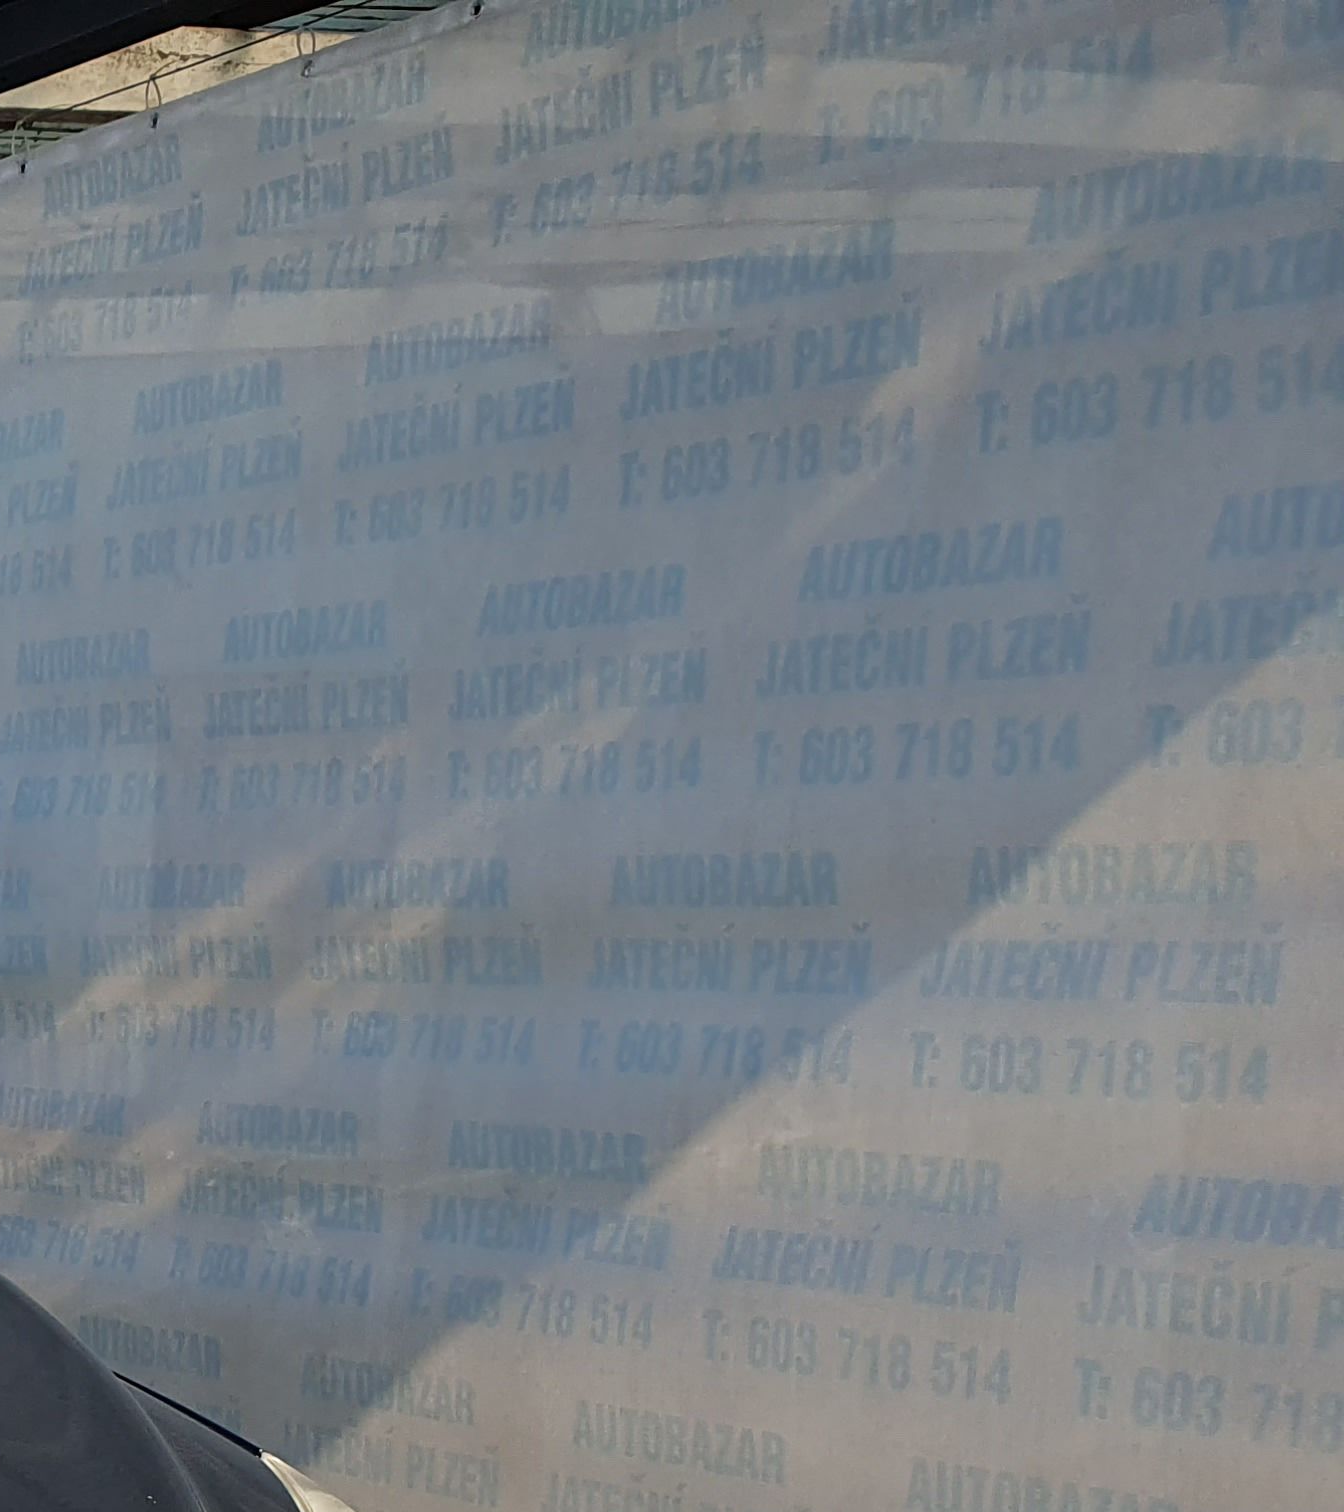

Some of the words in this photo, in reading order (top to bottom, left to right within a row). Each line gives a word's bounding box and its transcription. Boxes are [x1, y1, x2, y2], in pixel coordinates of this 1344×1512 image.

[793, 290, 921, 384] PLZEŇ
[132, 360, 285, 430] AUTOBAZAR
[475, 363, 576, 445] PLZEŇ
[975, 393, 1008, 448] T:
[1030, 377, 1112, 440] 603
[1143, 356, 1230, 422] 718
[221, 418, 304, 490] PLZEŇ
[618, 455, 645, 503] T:
[662, 442, 725, 496] 603
[749, 426, 816, 482] 718
[8, 461, 77, 526] PLZEŇ
[334, 501, 355, 544] T:
[369, 490, 420, 538] 603
[439, 479, 492, 529] 718
[510, 466, 571, 518] 514
[32, 548, 73, 589] 514
[103, 539, 120, 577] T:
[131, 530, 173, 573] 603
[188, 519, 231, 564] 718
[246, 511, 295, 557] 514
[804, 520, 1062, 598] AUTOBAZAR
[224, 602, 388, 660] AUTOBAZAR
[481, 567, 684, 633] AUTOBAZAR
[15, 632, 151, 683] AUTOBAZAR
[597, 632, 708, 707] PLZEŇ
[949, 594, 1091, 680] PLZEŇ
[99, 684, 173, 744] PLZEŇ
[321, 661, 411, 728] PLZEŇ
[752, 734, 781, 781] T:
[799, 730, 869, 780] 603
[896, 722, 969, 775] 718
[995, 717, 1080, 771] 514
[1209, 703, 1300, 761] 603
[15, 779, 52, 815] 603
[199, 770, 217, 808] T:
[230, 765, 276, 805] 603
[292, 760, 339, 802] 718
[354, 758, 407, 801] 514
[447, 754, 470, 796] T:
[636, 739, 703, 786] 514
[612, 856, 836, 903] AUTOBAZAR
[444, 921, 542, 984] PLZEŇ
[750, 923, 874, 994] PLZEŇ
[1126, 922, 1285, 1002] PLZEŇ
[311, 1011, 331, 1050] T:
[409, 1016, 461, 1058] 718
[477, 1019, 536, 1063] 514
[578, 1024, 603, 1068] T:
[616, 1025, 677, 1071] 603
[698, 1029, 762, 1077] 718
[908, 1035, 940, 1084] T:
[960, 1037, 1038, 1089] 603
[1066, 1040, 1148, 1094] 718
[1176, 1043, 1271, 1099] 514
[449, 1122, 645, 1181] AUTOBAZAR
[200, 1243, 244, 1285] 603
[319, 1260, 371, 1306] 514
[517, 1286, 573, 1334] 718
[591, 1296, 655, 1347] 514
[702, 1311, 729, 1358] T:
[746, 1317, 813, 1371] 603
[837, 1331, 908, 1387] 718
[931, 1343, 1012, 1401] 514
[1074, 1361, 1109, 1415] T:
[1132, 1367, 1218, 1429] 603
[572, 1403, 787, 1484] AUTOBAZAR
